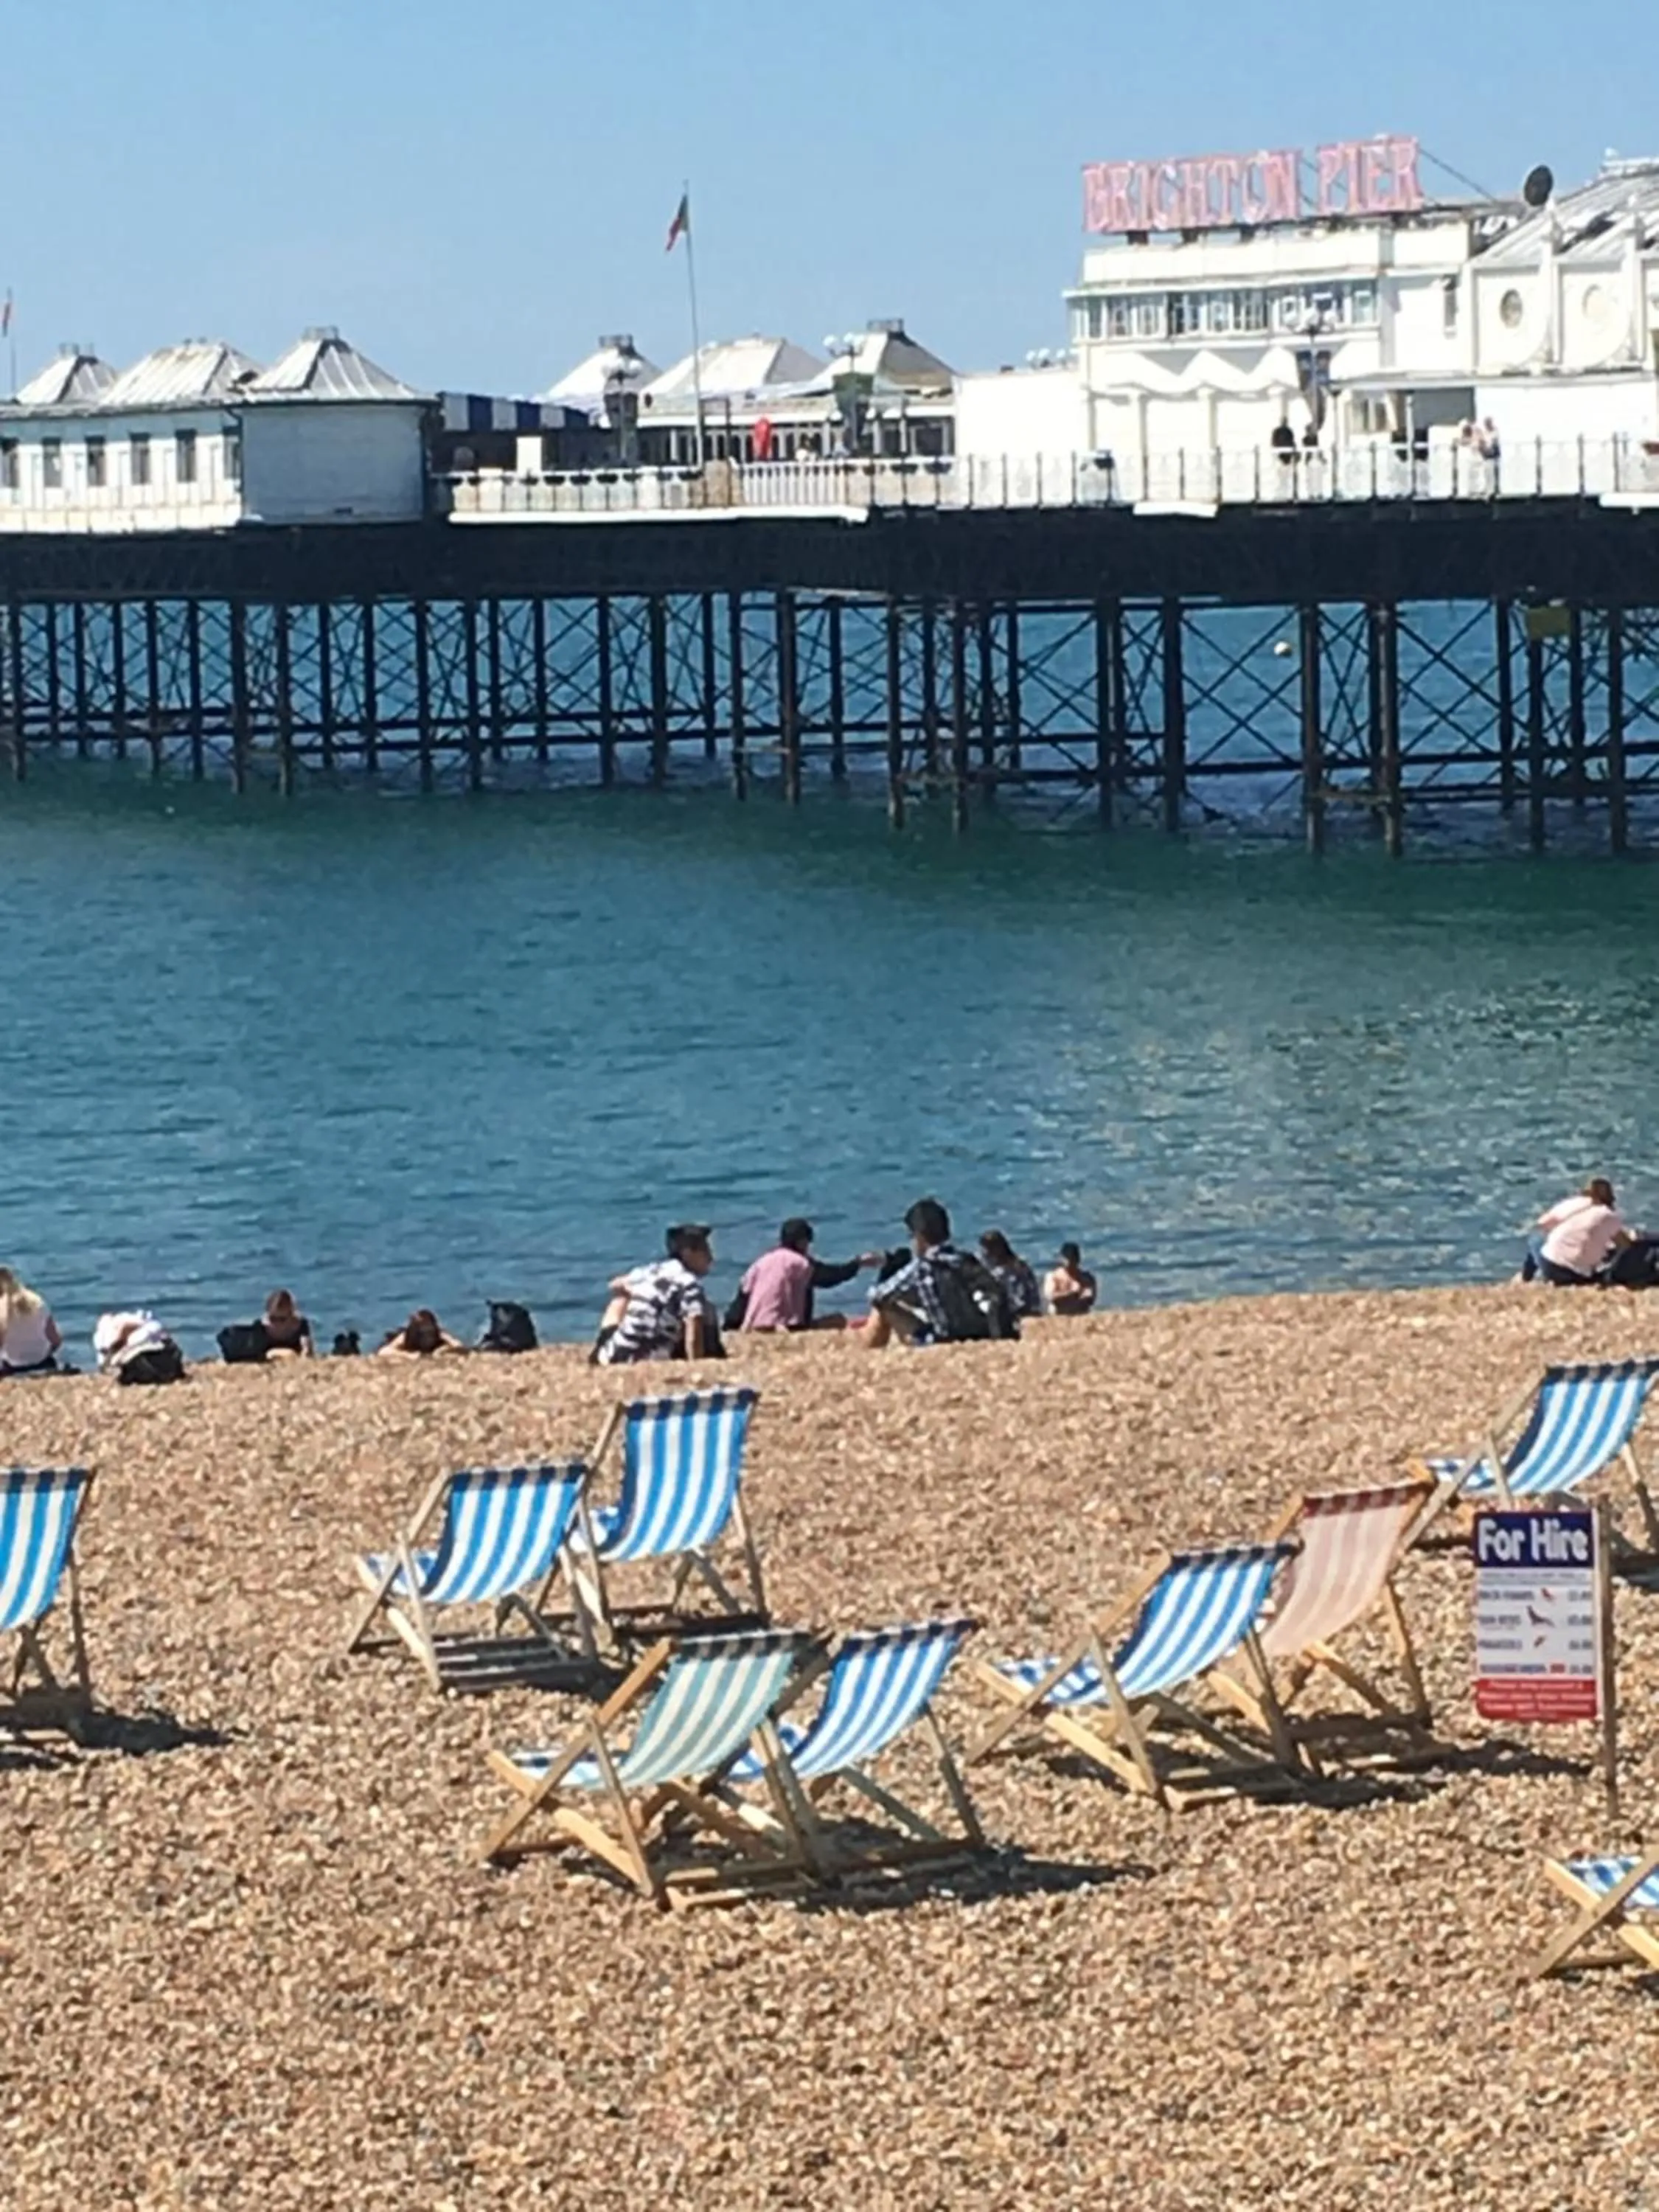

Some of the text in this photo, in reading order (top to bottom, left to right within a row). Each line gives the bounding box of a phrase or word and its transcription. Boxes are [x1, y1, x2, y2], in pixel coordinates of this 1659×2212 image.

[1082, 134, 1424, 233] BRIGHTON PIER
[1478, 1517, 1588, 1561] For Hire
